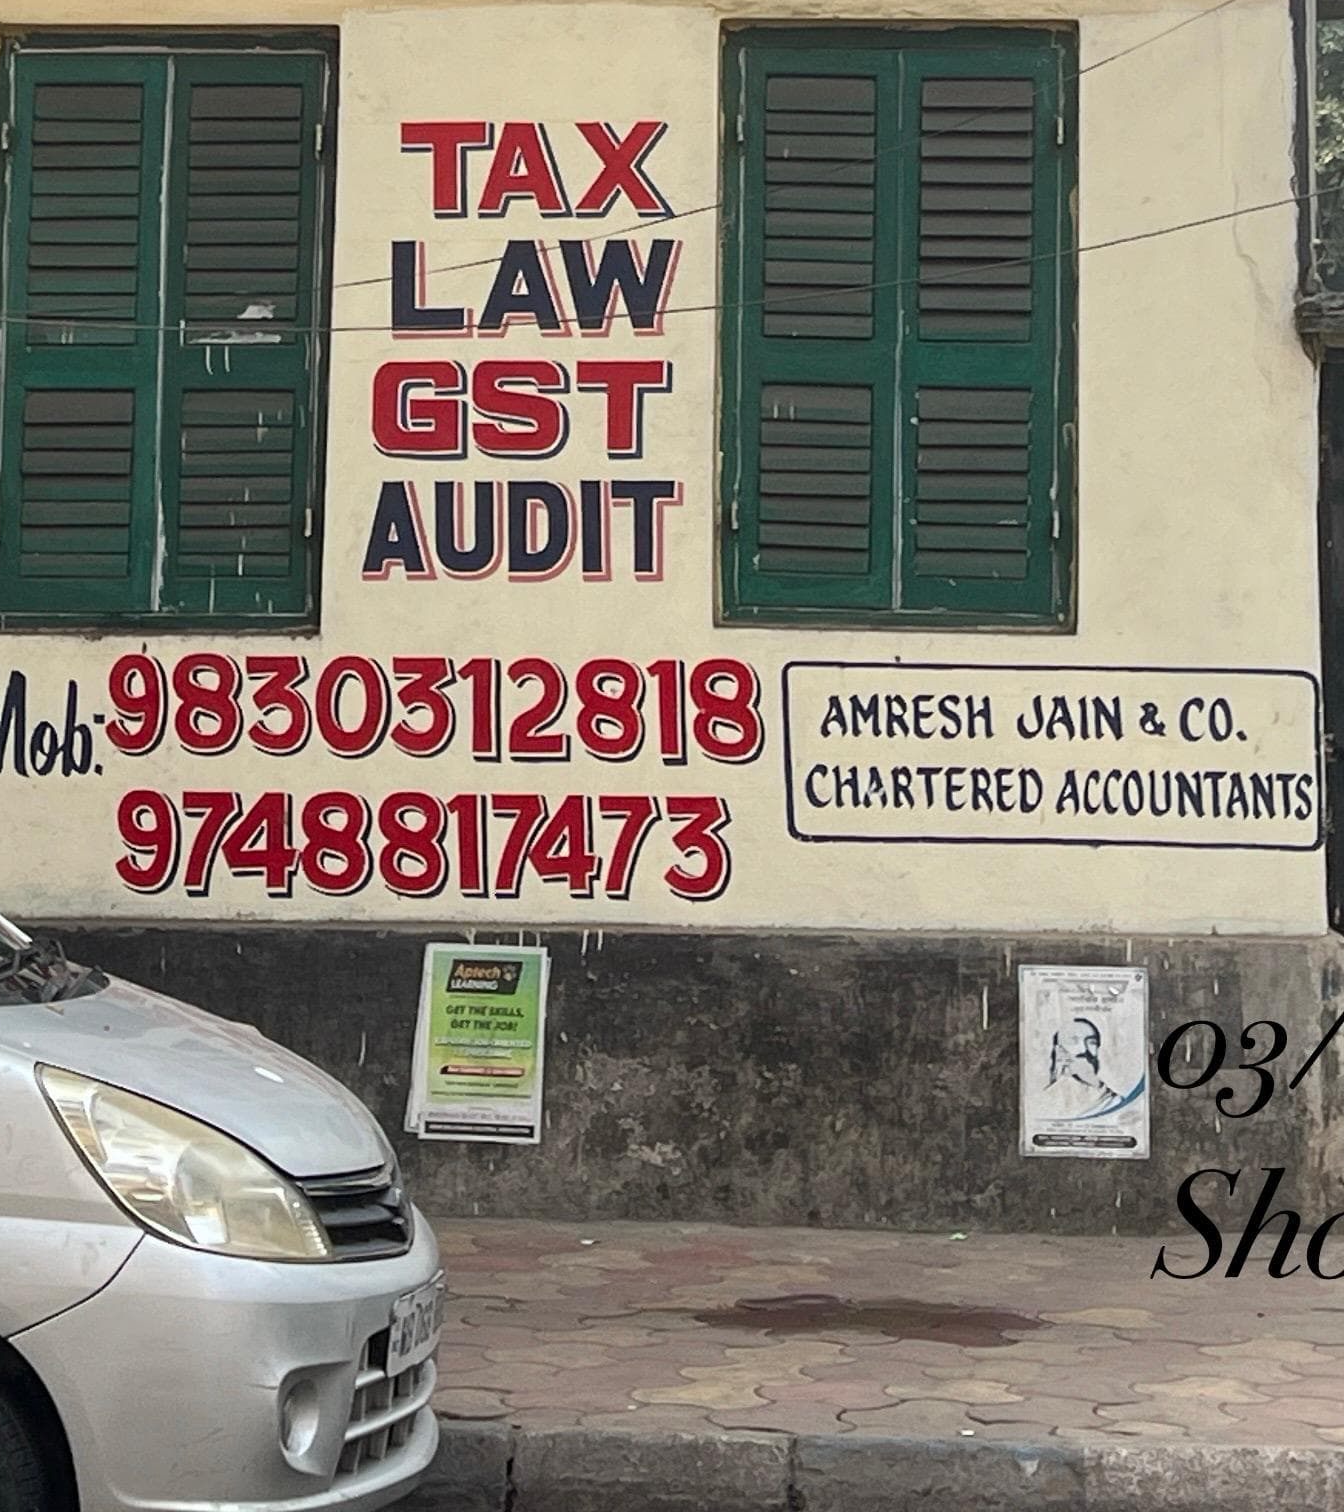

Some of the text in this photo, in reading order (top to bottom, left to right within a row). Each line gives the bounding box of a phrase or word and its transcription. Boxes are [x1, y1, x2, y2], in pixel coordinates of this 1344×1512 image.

[401, 121, 674, 219] TAX
[391, 239, 683, 338] LAW
[372, 360, 673, 460] GST
[362, 480, 683, 582] AUDIT
[105, 653, 764, 763] 9830312818
[820, 694, 1248, 743] AMRESH JAIN & CO.
[805, 763, 1313, 821] CHARTERED ACCOUNTANTS
[116, 789, 731, 899] 9748817473
